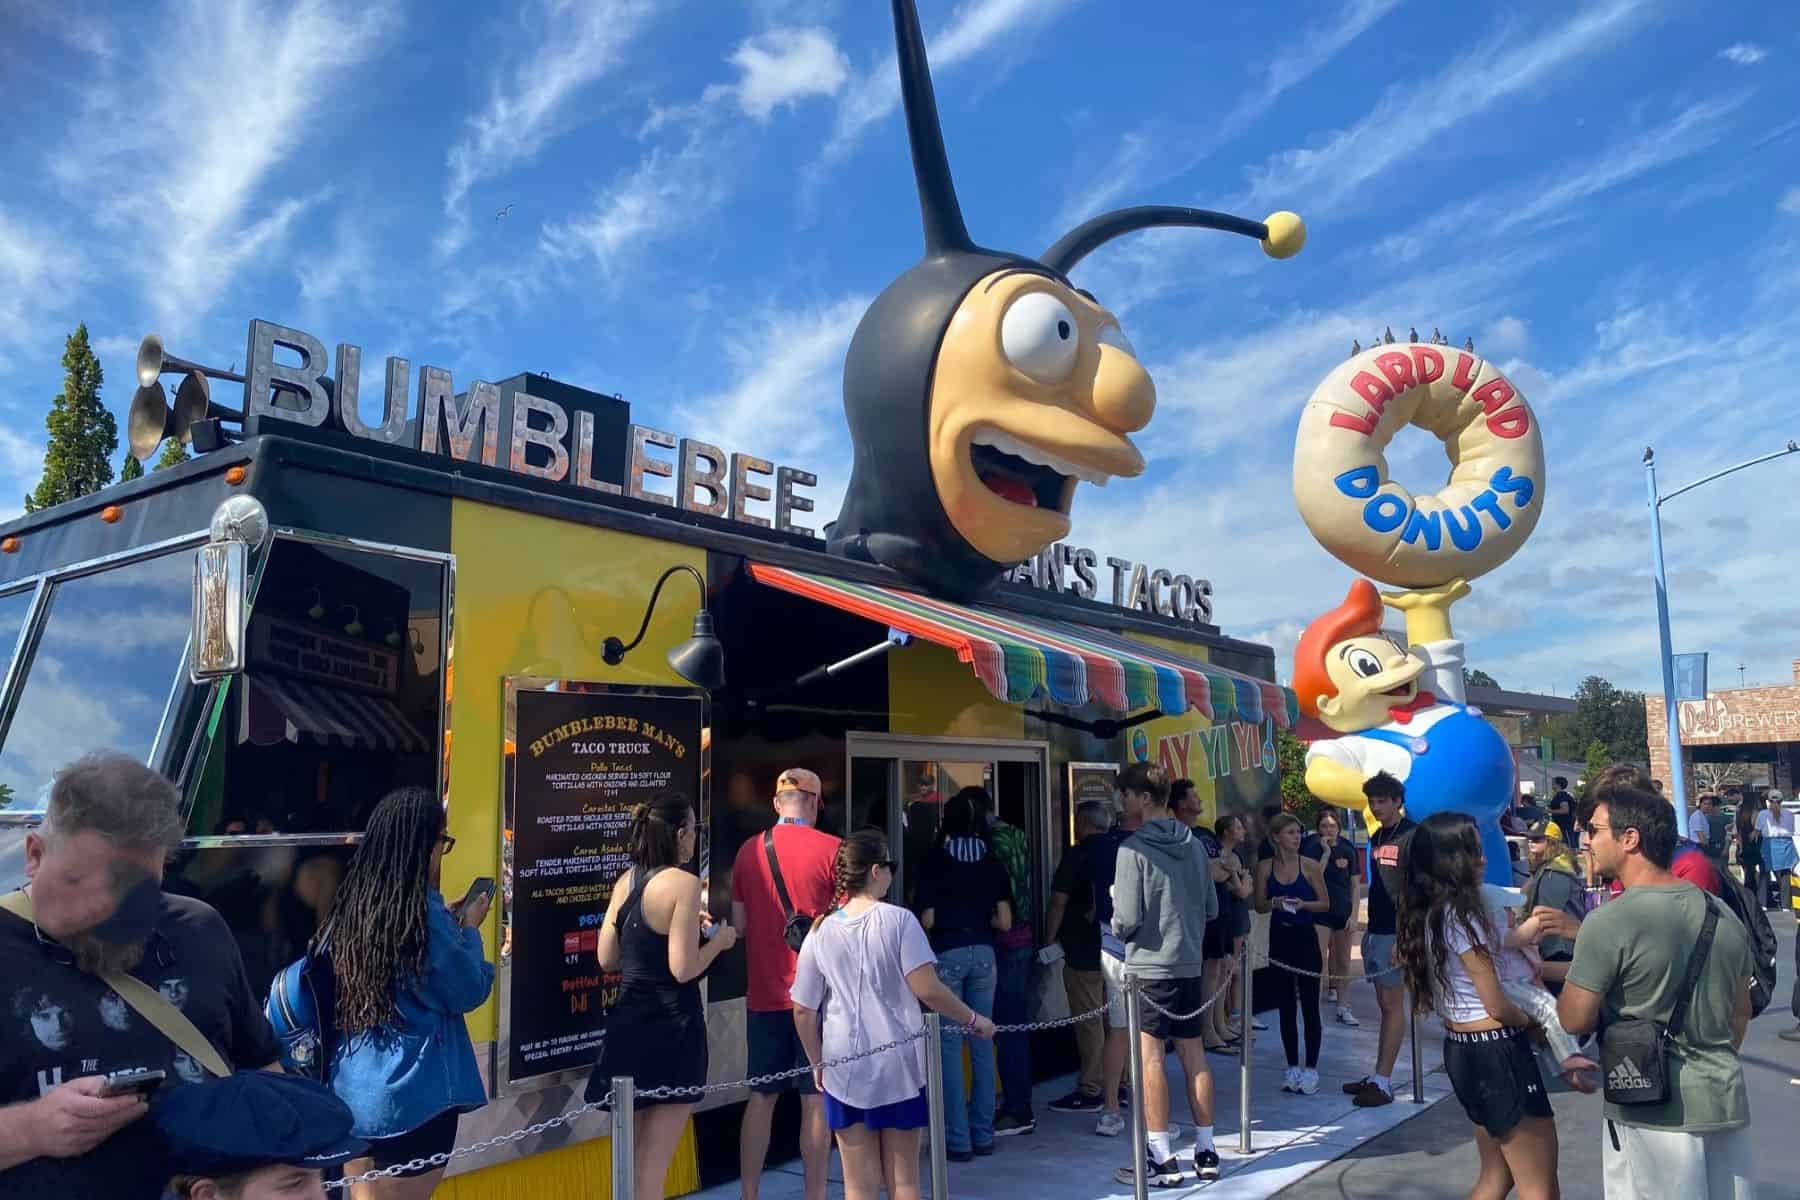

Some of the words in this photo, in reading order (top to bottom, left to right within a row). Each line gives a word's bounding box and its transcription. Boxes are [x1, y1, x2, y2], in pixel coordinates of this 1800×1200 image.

[1329, 345, 1445, 436] LARD
[1452, 353, 1530, 439] LAD
[247, 318, 817, 537] BUMBLEBEE
[1107, 557, 1213, 624] TACOS
[1334, 465, 1535, 552] DONUTS
[529, 715, 639, 758] BUMBLEBEE
[641, 721, 686, 759] MAN'S
[571, 742, 605, 754] TACO
[608, 742, 651, 754] TRUCK
[1158, 733, 1194, 779] AY
[1199, 725, 1231, 780] YI
[1231, 722, 1261, 771] YI
[552, 782, 585, 790] TORTILLAS
[586, 781, 603, 789] WITH
[614, 812, 632, 820] SERVE
[551, 824, 585, 832] TORTILLAS
[586, 823, 602, 831] WITH
[519, 868, 538, 878] SOFT
[540, 866, 563, 876] FLOUR
[565, 863, 602, 874] TORTILLAS
[602, 862, 621, 870] WITH
[536, 858, 562, 868] TENDER
[545, 887, 565, 897] TACOS
[80, 1058, 99, 1073] THE
[1608, 1077, 1653, 1090] adidas
